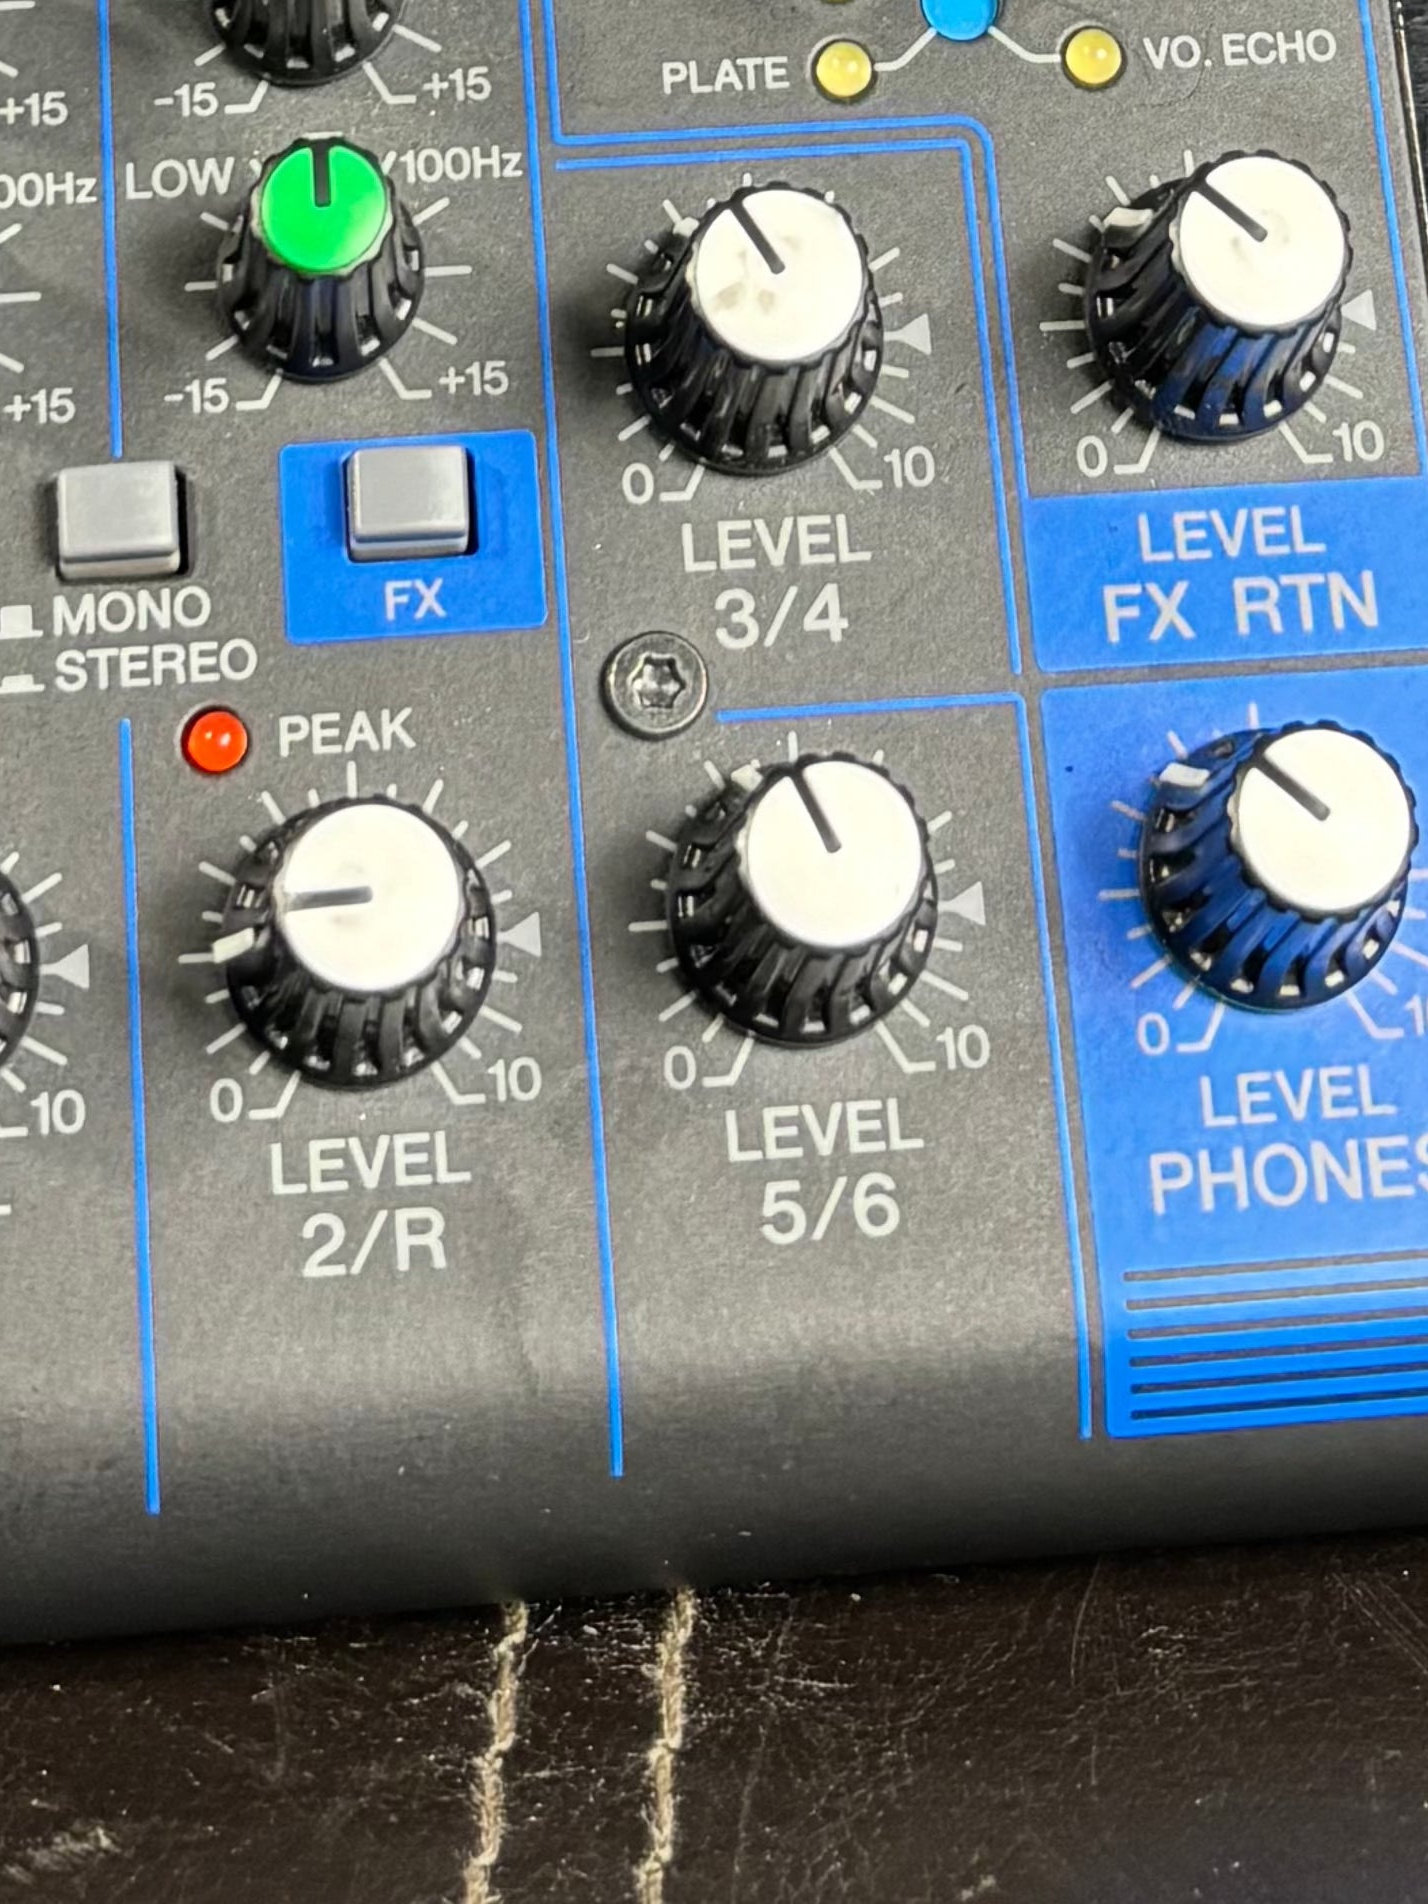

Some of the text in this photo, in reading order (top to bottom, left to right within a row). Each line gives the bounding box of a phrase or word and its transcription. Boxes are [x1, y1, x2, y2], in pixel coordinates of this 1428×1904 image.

[1142, 28, 1337, 71] VO. ECHO
[422, 66, 492, 102] +15
[662, 55, 791, 95] PLATE
[154, 81, 219, 118] -15
[125, 156, 235, 200] LOW
[399, 144, 523, 185] 100Hz
[164, 377, 230, 415] -15
[437, 360, 509, 396] +15
[2, 387, 76, 425] +15
[1076, 435, 1109, 478] 0
[1332, 420, 1385, 462] 10
[621, 462, 655, 506] 0
[883, 445, 936, 489] 10
[681, 513, 872, 573] LEVEL
[1138, 504, 1327, 563] LEVEL
[52, 585, 212, 637] MONO
[384, 577, 447, 621] FX
[714, 583, 849, 652] 3/4
[1103, 569, 1379, 644] FX RTN
[54, 638, 258, 693] STEREO
[278, 707, 417, 758] PEAK
[935, 1024, 991, 1071] 10
[1137, 1012, 1170, 1056] 0
[486, 1056, 542, 1103] 10
[663, 1045, 697, 1091] 0
[30, 1089, 86, 1136] 10
[209, 1078, 244, 1124] 0
[1200, 1063, 1398, 1128] LEVEL
[725, 1097, 925, 1163] LEVEL
[269, 1130, 472, 1195] LEVEL
[759, 1172, 901, 1246] 5/6
[301, 1206, 447, 1278] 2/R
